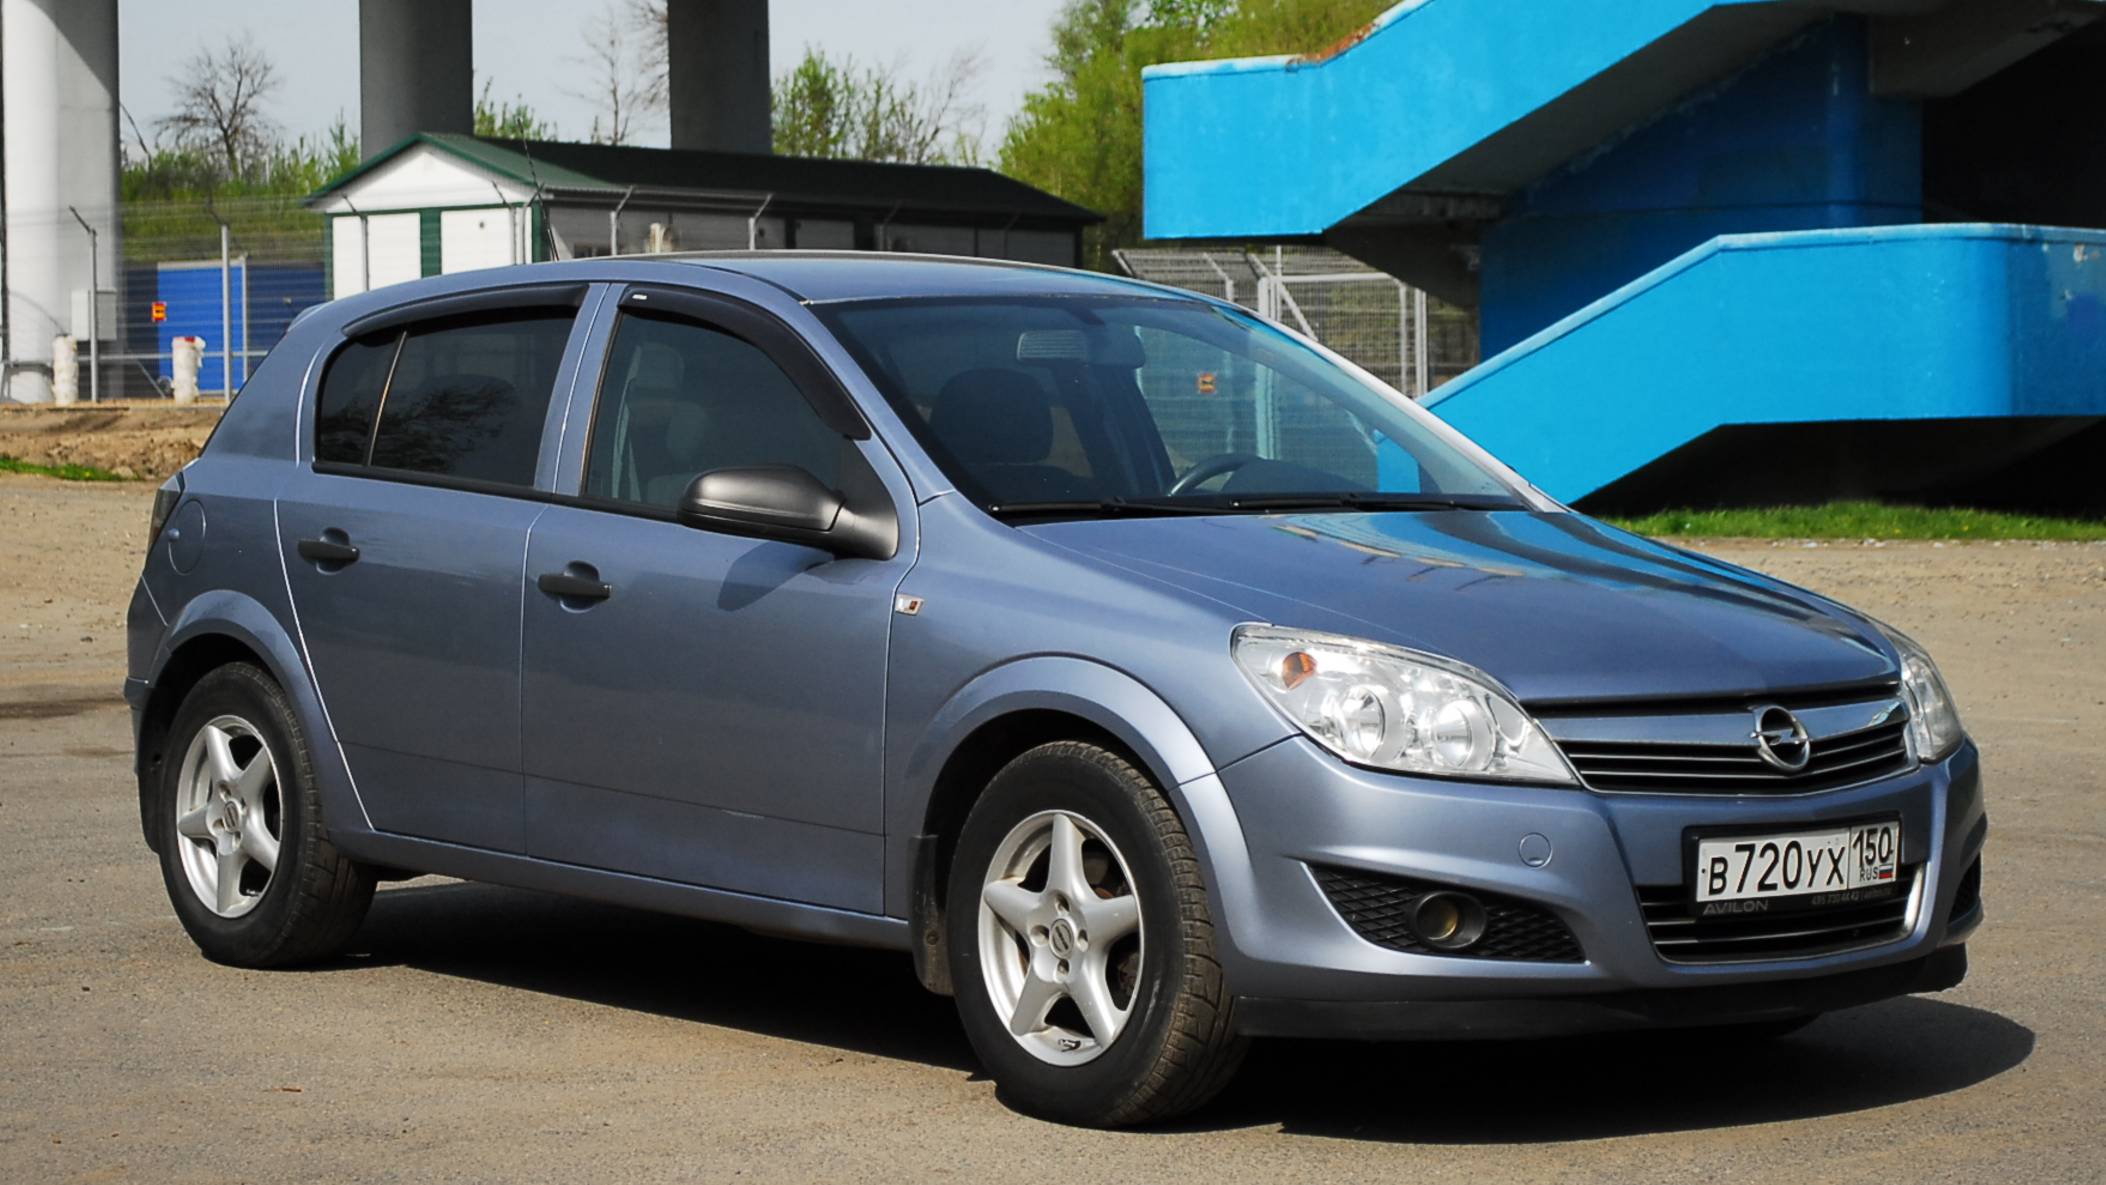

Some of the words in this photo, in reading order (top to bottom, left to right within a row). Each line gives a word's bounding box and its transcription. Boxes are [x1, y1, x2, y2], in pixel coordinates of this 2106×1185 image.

[1852, 826, 1892, 867] 150
[1859, 866, 1878, 881] RUS
[1703, 900, 1768, 915] AVILON
